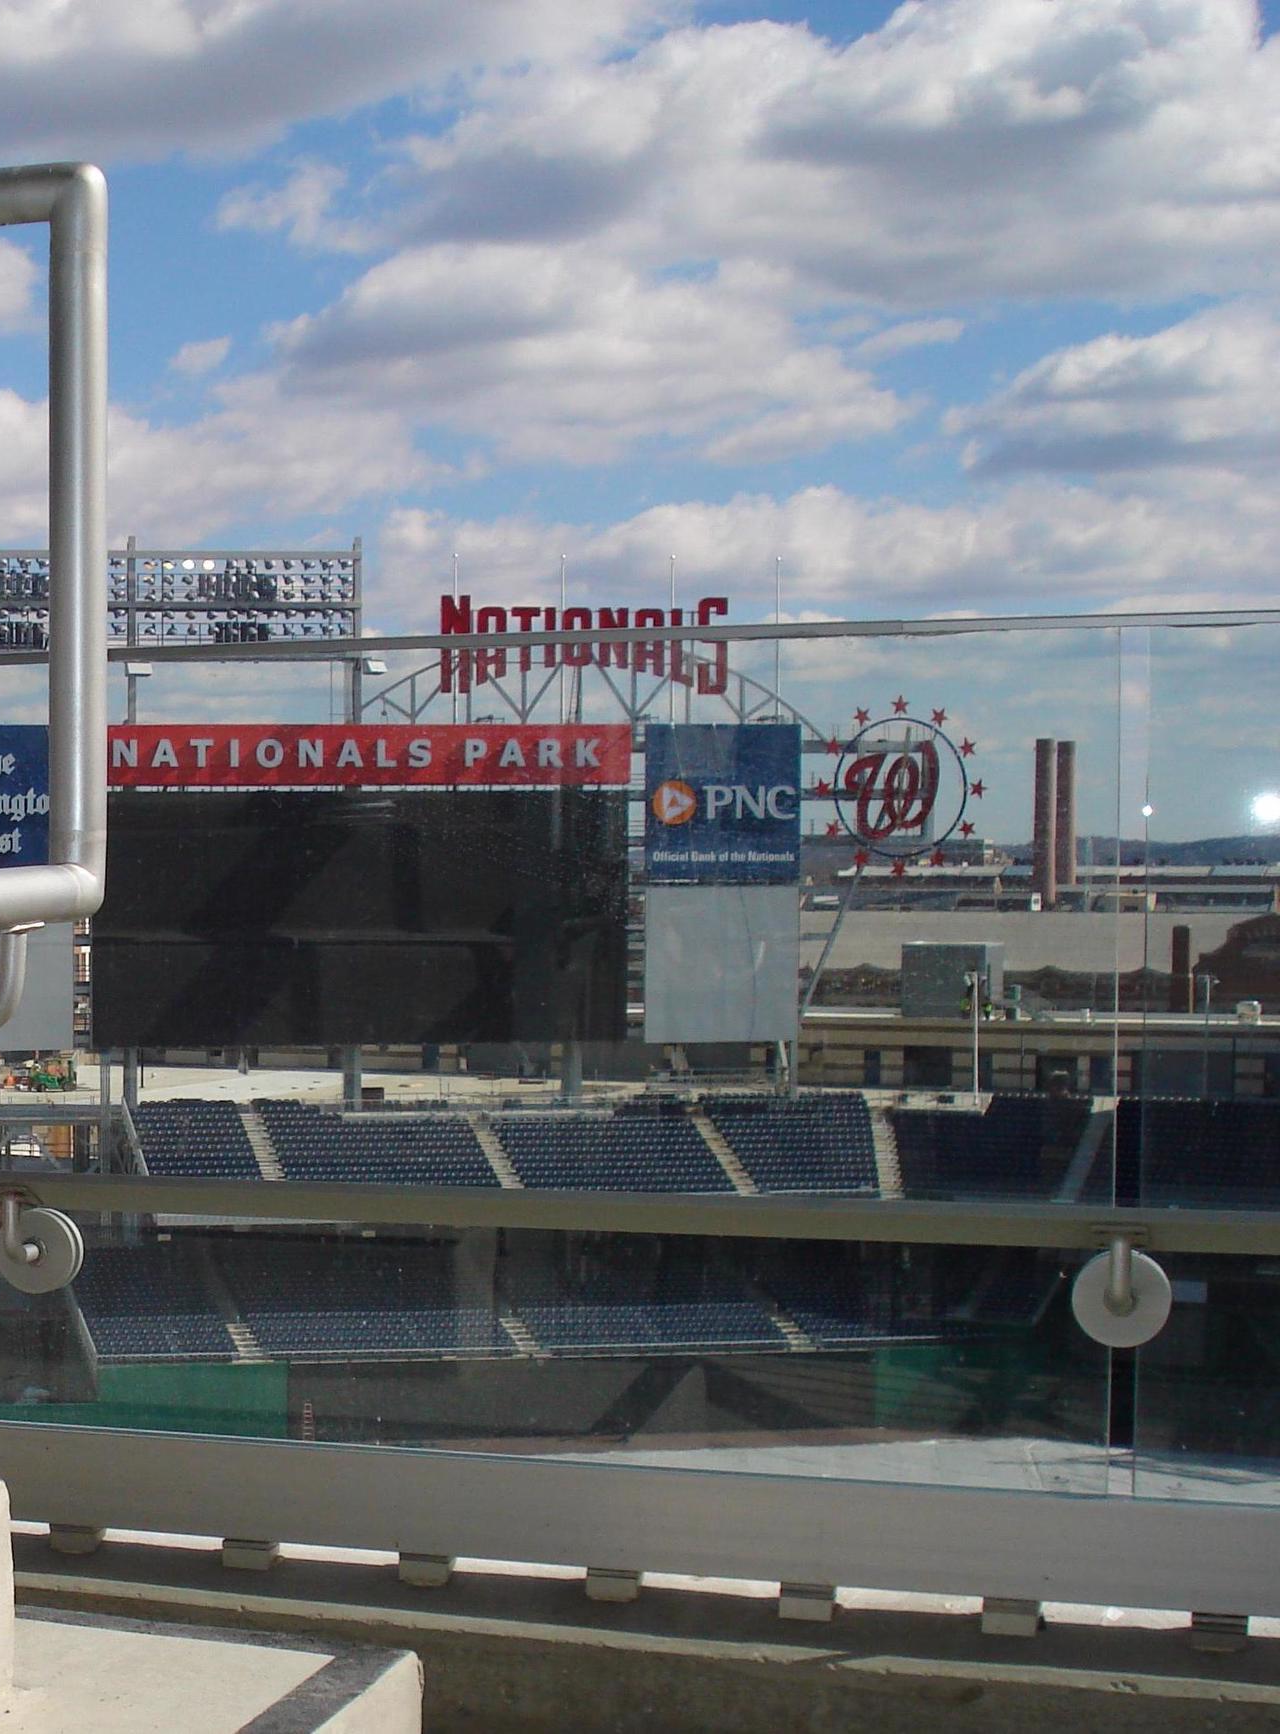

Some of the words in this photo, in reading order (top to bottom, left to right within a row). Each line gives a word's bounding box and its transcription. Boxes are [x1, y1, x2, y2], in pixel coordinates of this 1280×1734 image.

[111, 738, 432, 768] NATIONALS
[464, 738, 602, 768] PARK
[702, 785, 797, 820] PNC
[652, 851, 689, 862] Official
[691, 851, 717, 862] Bank
[719, 851, 729, 862] of
[731, 851, 746, 862] the
[748, 851, 795, 863] Nationals
